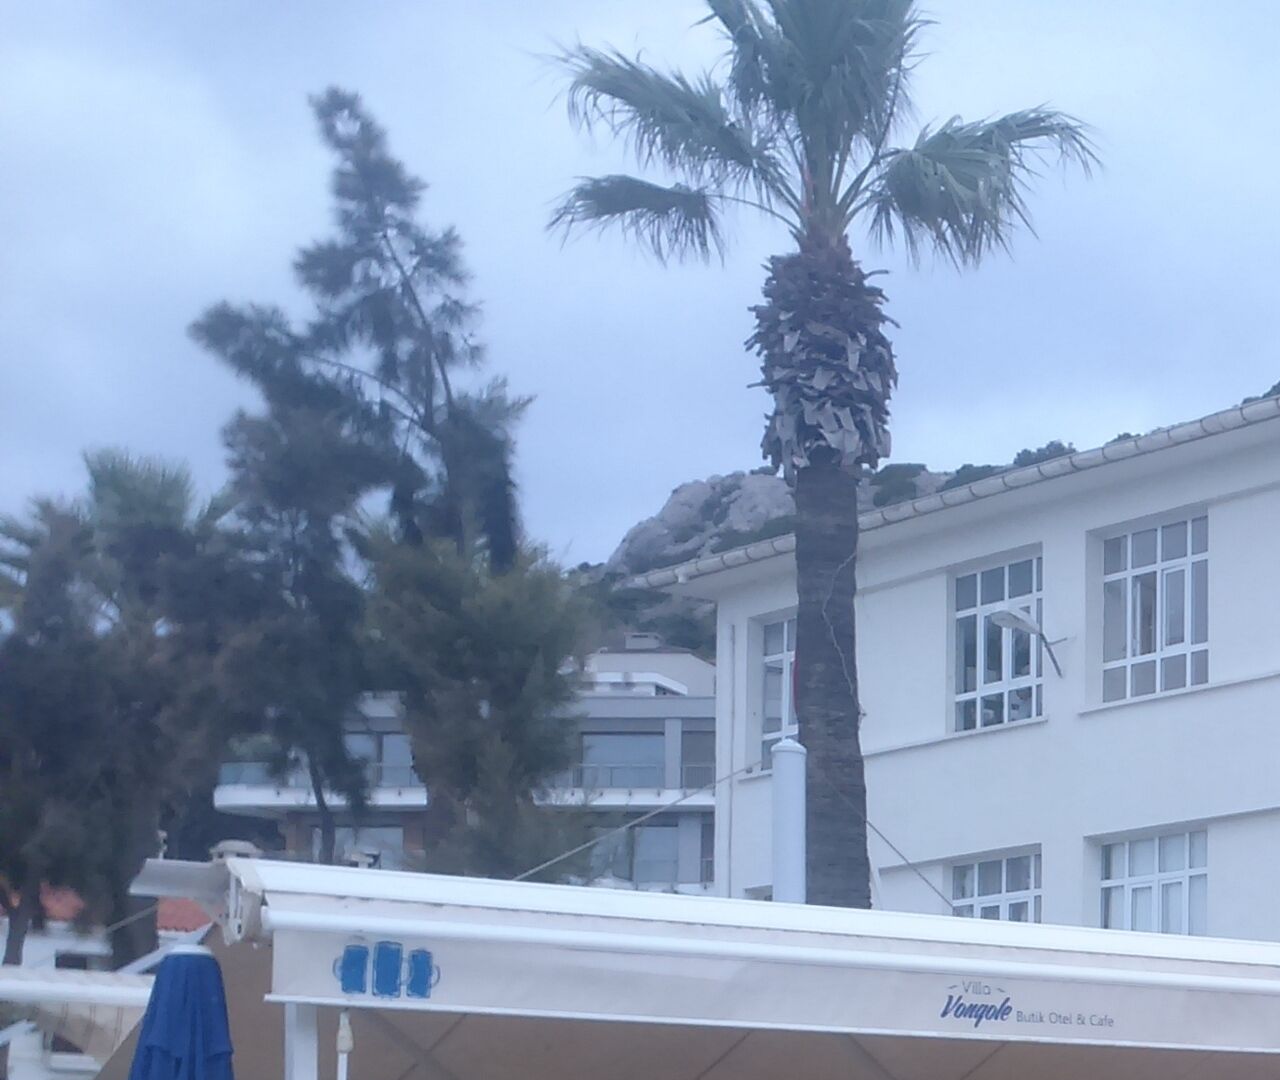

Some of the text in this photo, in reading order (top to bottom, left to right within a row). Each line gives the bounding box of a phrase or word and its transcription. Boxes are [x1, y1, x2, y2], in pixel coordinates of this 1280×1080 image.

[962, 980, 992, 995] Villa
[940, 994, 1114, 1028] Vongole Butik Otel & Cafe
